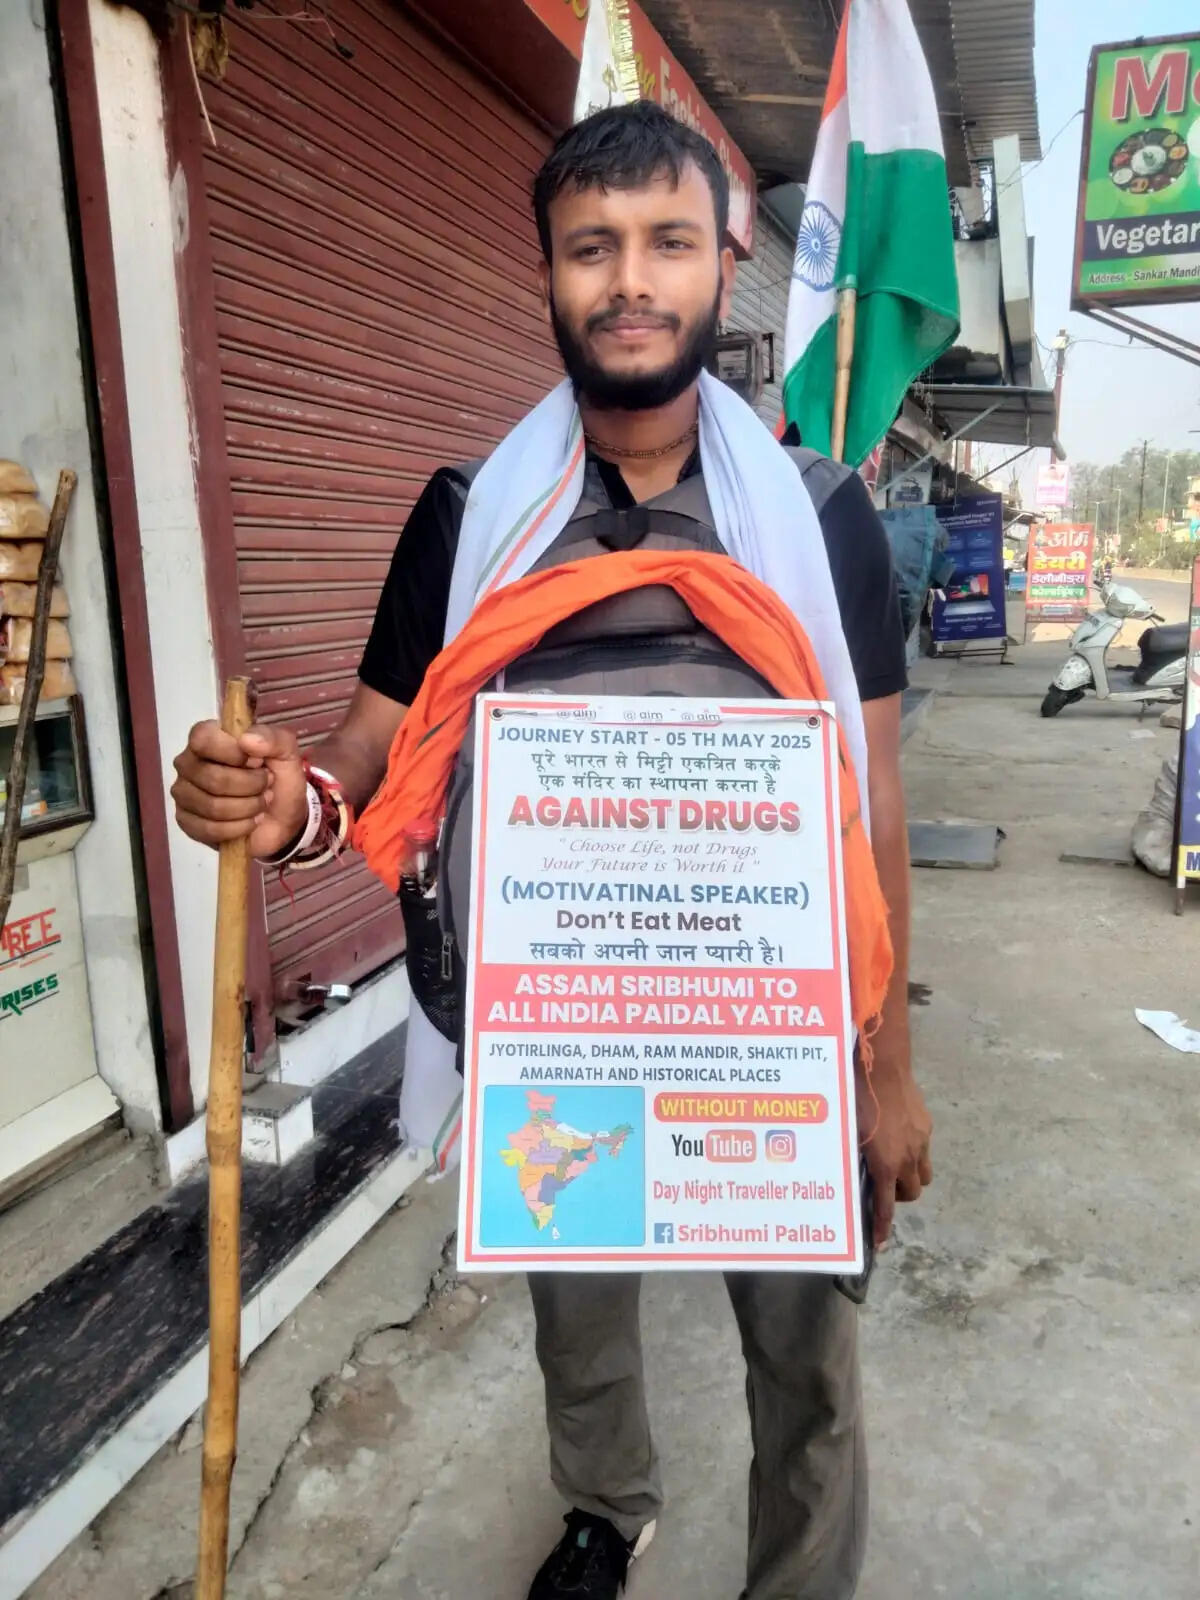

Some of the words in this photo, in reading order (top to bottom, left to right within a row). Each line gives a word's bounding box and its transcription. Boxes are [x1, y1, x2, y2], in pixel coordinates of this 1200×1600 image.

[1112, 51, 1200, 120] M
[1133, 269, 1167, 281] Sankar
[498, 727, 584, 743] JOURNEY
[591, 730, 648, 745] START
[666, 731, 686, 746] 05
[692, 732, 716, 747] TH
[722, 733, 765, 748] MAY
[771, 734, 811, 749] 2025
[531, 749, 555, 772] पूरे
[566, 754, 608, 769] भारत
[615, 751, 628, 769] से
[636, 751, 673, 774] मिट्टी
[680, 752, 736, 773] एकत्रित
[744, 754, 781, 772] करके
[538, 774, 565, 791] एक
[572, 771, 615, 790] मंदिर
[622, 776, 642, 790] का
[650, 777, 708, 792] स्थापना
[715, 779, 758, 793] करना
[764, 772, 777, 794] है
[507, 795, 672, 830] AGAINST
[679, 799, 801, 833] DRUGS
[672, 842, 700, 854] not
[706, 842, 758, 859] Drugs
[540, 857, 584, 872] Your
[586, 858, 648, 872] Future
[654, 860, 667, 872] is
[675, 858, 727, 873] Worth
[502, 875, 684, 905] (MOTIVATINAL
[690, 881, 809, 910] SPEAKER)
[556, 910, 625, 930] Don't
[631, 912, 671, 931] Eat
[677, 911, 741, 931] Meat
[529, 938, 585, 960] सबको
[594, 938, 649, 961] अपनी
[656, 945, 697, 961] जान
[704, 939, 753, 963] प्यारी
[514, 973, 615, 996] ASSAM
[621, 975, 754, 998] SRIBHUMI
[760, 977, 798, 999] TO
[487, 1001, 536, 1023] ALL
[541, 1002, 619, 1024] INDIA
[625, 1003, 726, 1025] PAIDAL
[731, 1004, 825, 1027] YATRA
[489, 1043, 587, 1059] JYOTIRLINGA,
[591, 1044, 639, 1060] DHAM,
[644, 1045, 677, 1059] RAM
[681, 1046, 743, 1061] MANDIR,
[747, 1046, 797, 1060] SHAKTI
[802, 1047, 828, 1062] PIT,
[519, 1066, 603, 1081] AMARNATH
[608, 1067, 639, 1081] AND
[643, 1068, 726, 1082] HISTORICAL
[730, 1069, 781, 1082] PLACES
[660, 1098, 748, 1116] WITHOUT
[753, 1099, 820, 1117] MONEY
[653, 1180, 680, 1204] Day
[684, 1179, 723, 1204] Night
[726, 1181, 788, 1200] Traveller
[792, 1181, 835, 1201] Pallab
[678, 1224, 768, 1243] Sribhumi
[775, 1224, 836, 1243] Pallab
